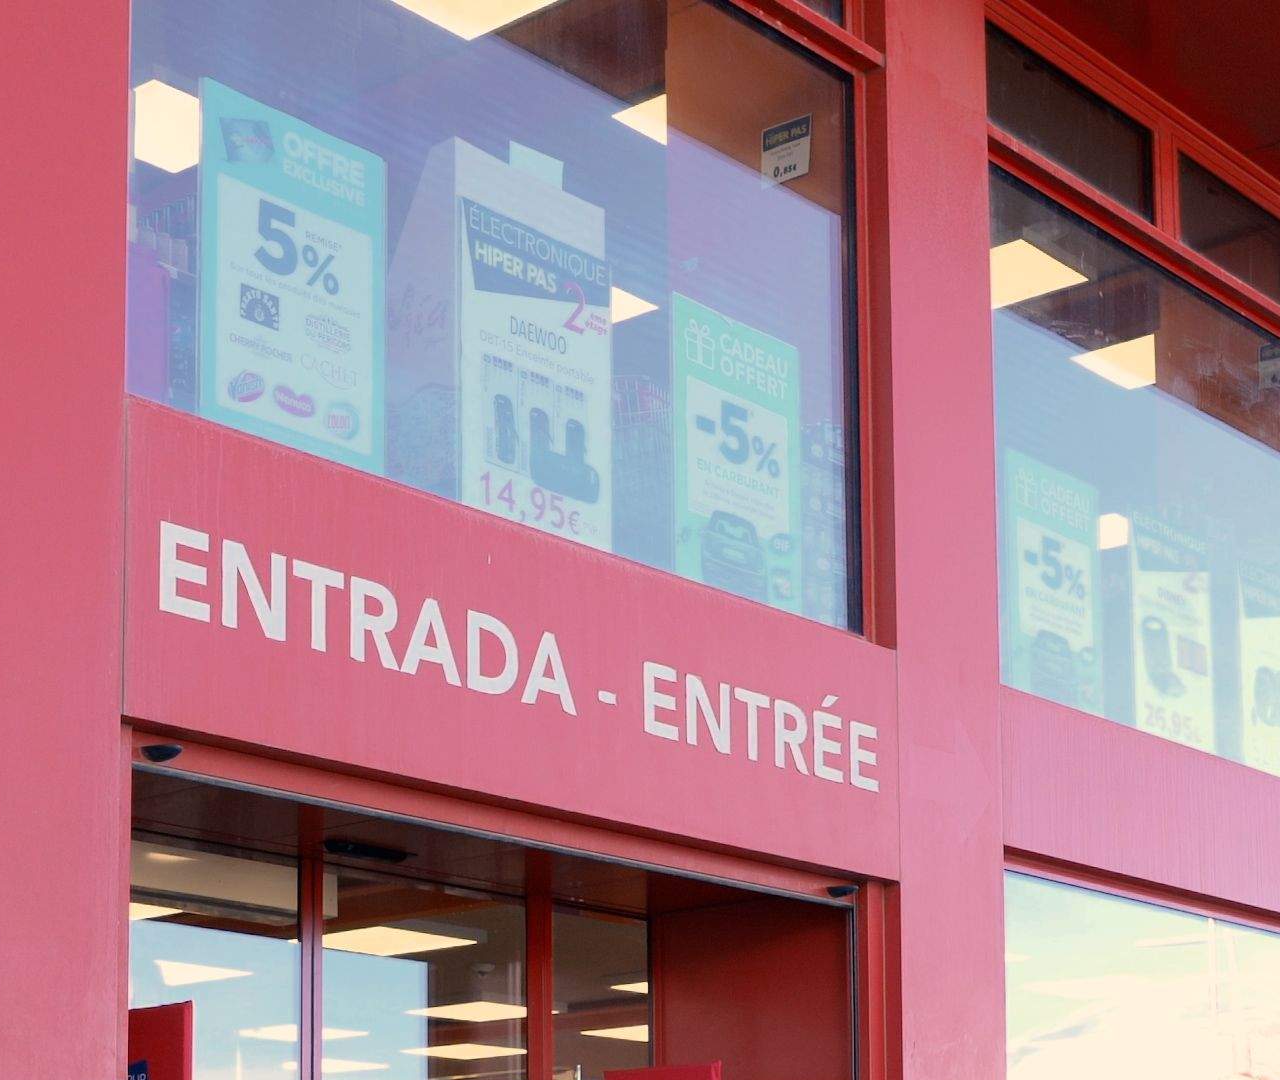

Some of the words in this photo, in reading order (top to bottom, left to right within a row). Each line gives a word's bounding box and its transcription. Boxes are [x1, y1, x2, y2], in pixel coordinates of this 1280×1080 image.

[283, 131, 366, 190] OFFRE
[283, 156, 366, 208] EXCLUSIVE
[470, 204, 607, 288] ÉLECTRONIQUE
[475, 240, 524, 280] HIPER
[527, 262, 558, 294] PAS
[510, 315, 568, 355] DAEWOO
[720, 332, 789, 378] CADEAU
[720, 355, 789, 399] OFFERT
[480, 470, 581, 536] 14,95€
[1040, 478, 1091, 515] CADEAU
[1040, 497, 1091, 533] OFFERT
[159, 519, 579, 718] ENTRADA
[642, 660, 881, 794] ENTRÉE
